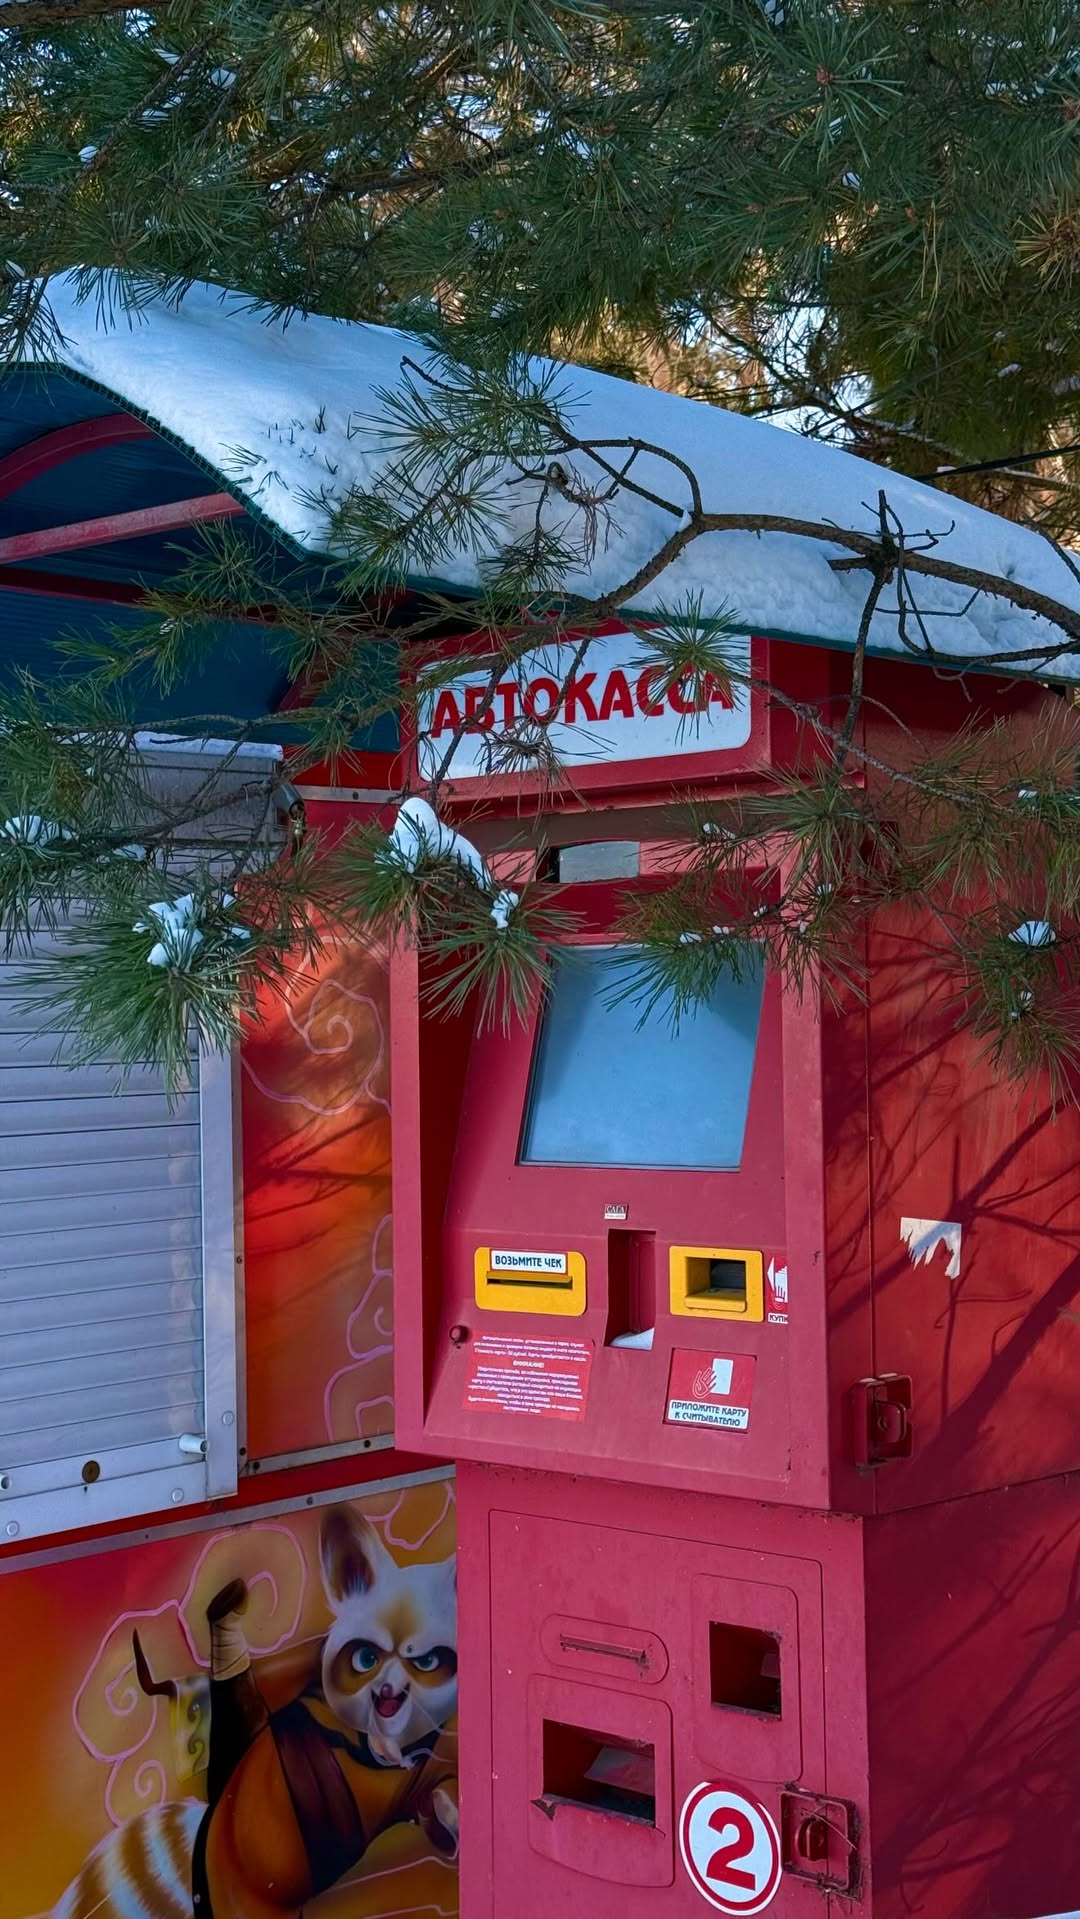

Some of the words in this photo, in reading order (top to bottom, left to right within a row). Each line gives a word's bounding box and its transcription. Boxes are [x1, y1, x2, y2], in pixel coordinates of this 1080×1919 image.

[431, 662, 734, 739] АВТОКАССА
[495, 1255, 542, 1267] ВОЗЬМИТЕ
[544, 1257, 562, 1268] ЧЕК
[671, 1401, 720, 1414] ПРИЛОЖИТЕ
[722, 1407, 747, 1417] КАРТУ
[674, 1411, 680, 1419] К
[682, 1412, 741, 1427] СЧИТЫВАТЕЛЮ
[706, 1807, 756, 1890] 2
